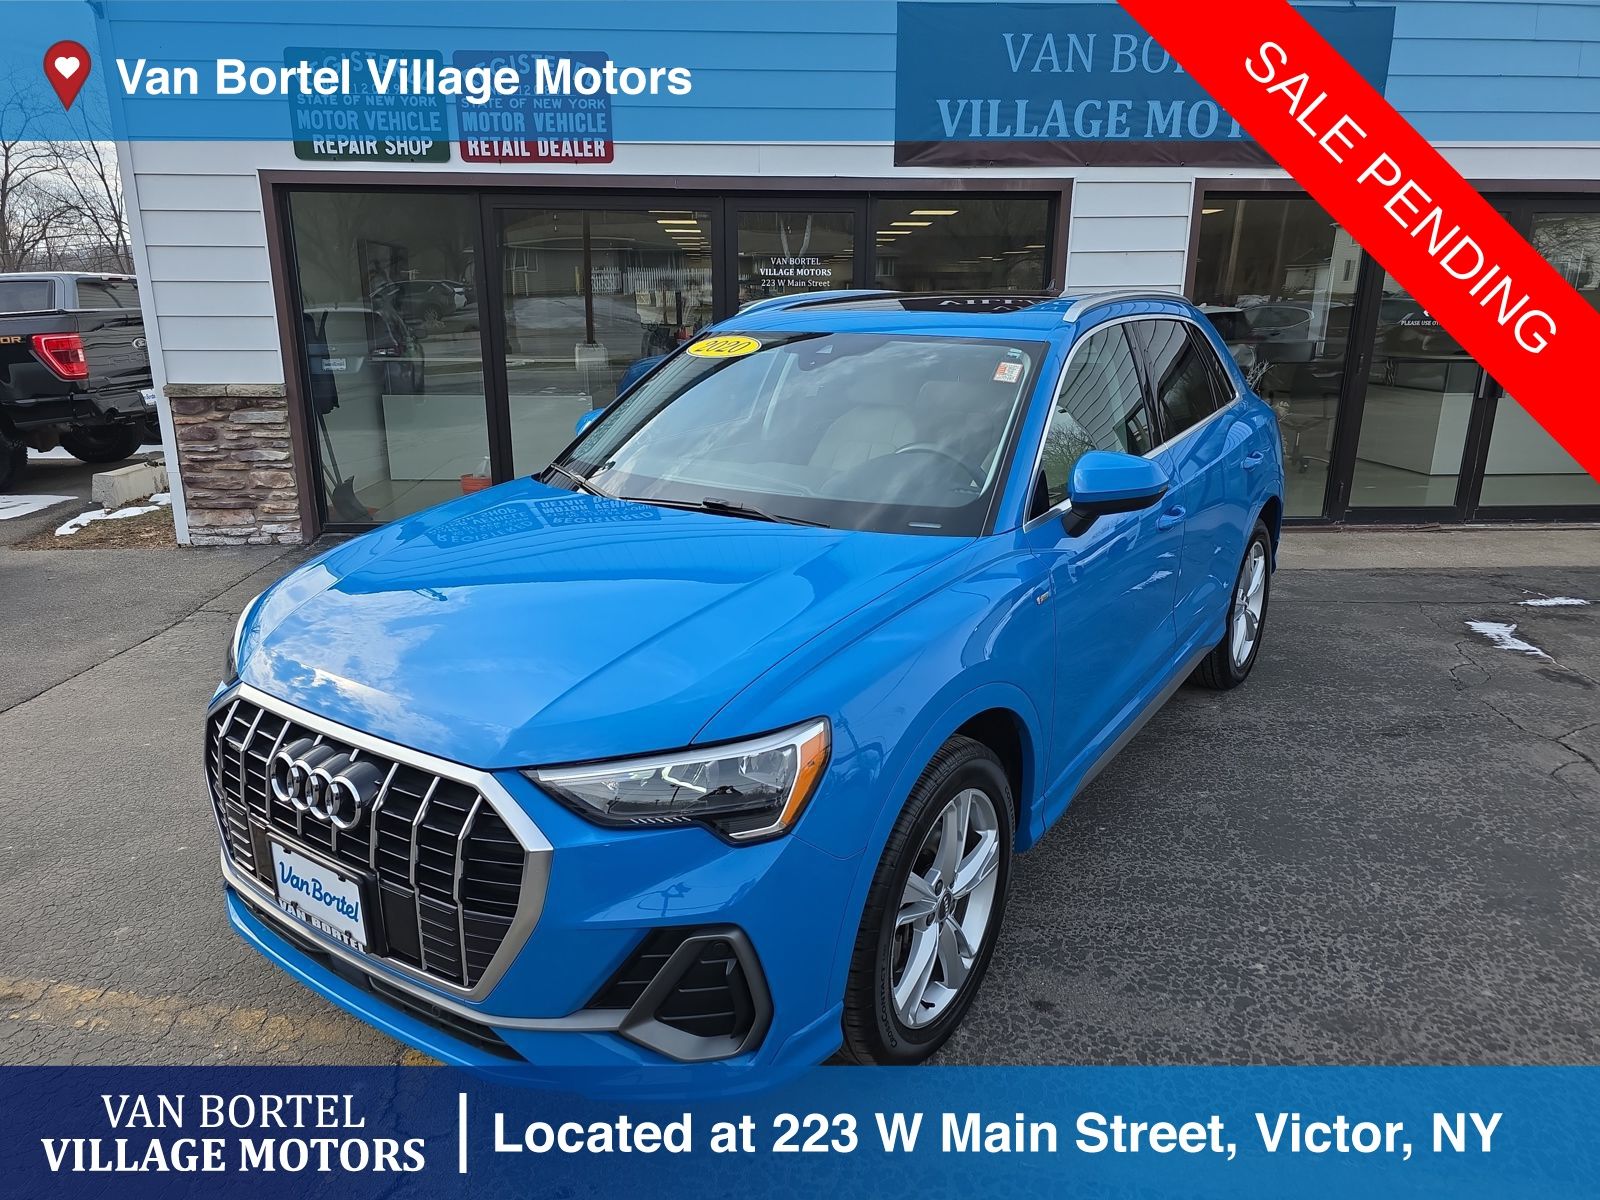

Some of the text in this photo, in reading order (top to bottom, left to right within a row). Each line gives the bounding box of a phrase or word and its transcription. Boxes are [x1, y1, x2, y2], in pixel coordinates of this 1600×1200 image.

[1002, 33, 1096, 73] VAN
[297, 94, 437, 107] STATE OF NEW YORK
[509, 98, 528, 109] OF
[533, 99, 562, 109] NEW
[568, 99, 606, 110] YORK
[297, 109, 442, 132] MOTOR VEHICLE
[462, 111, 607, 133] MOTOR VEHICLE
[936, 99, 1132, 138] VILLAGE
[312, 134, 433, 156] REPAIR SHOP
[467, 136, 606, 158] RETAIL DEALER
[770, 257, 821, 265] VAN BORTEL
[760, 268, 832, 276] VILLAGE MOTORS
[761, 279, 830, 287] 223 W Main Street
[694, 340, 751, 353] 2020
